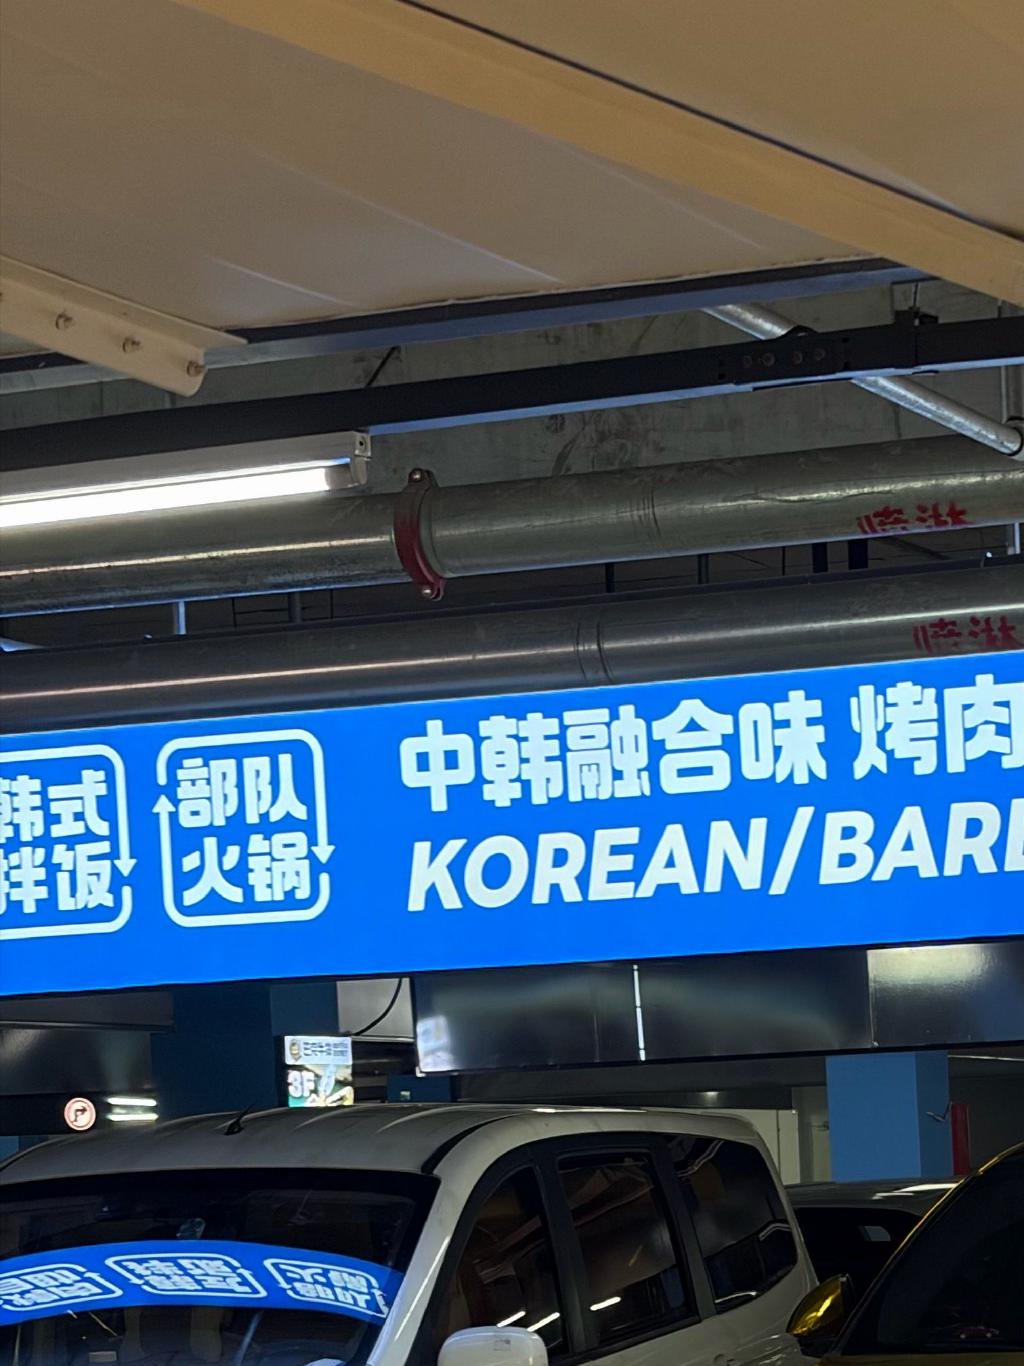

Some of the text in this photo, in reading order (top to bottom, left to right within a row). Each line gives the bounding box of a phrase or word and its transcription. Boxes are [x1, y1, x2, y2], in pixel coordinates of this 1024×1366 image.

[399, 689, 828, 812] 中韩融合味
[0, 768, 110, 844] 韩式
[176, 753, 308, 829] 部队
[0, 840, 115, 915] 拌饭
[181, 831, 312, 907] 火锅
